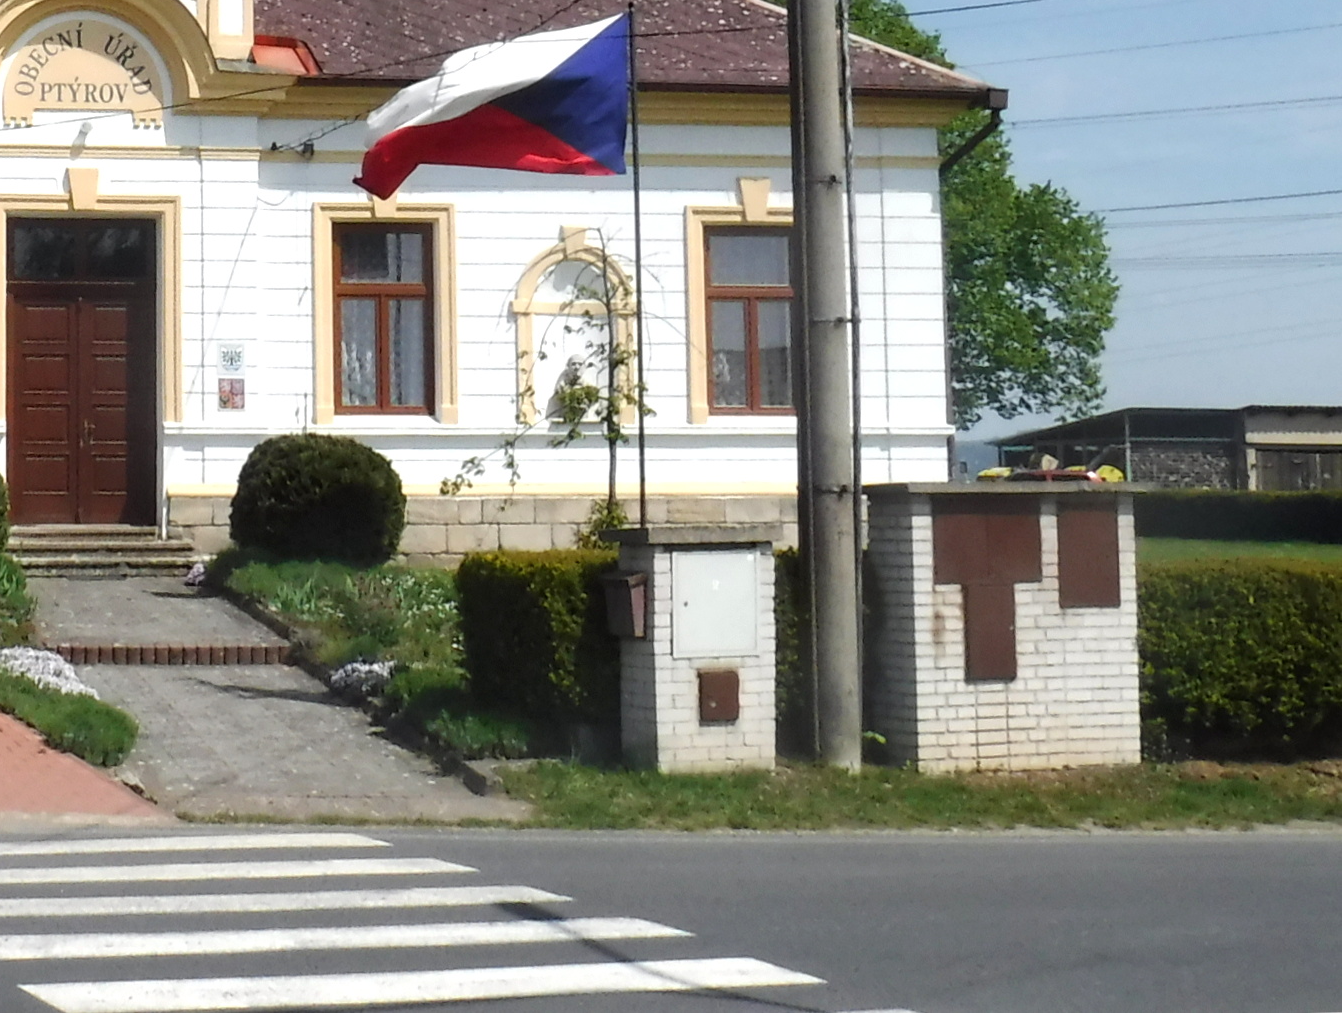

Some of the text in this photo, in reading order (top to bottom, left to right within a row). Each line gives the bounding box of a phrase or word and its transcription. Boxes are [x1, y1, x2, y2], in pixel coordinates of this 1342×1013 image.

[14, 22, 153, 97] OBECNÍ ÚŘAD
[39, 76, 129, 104] PTÝROV
